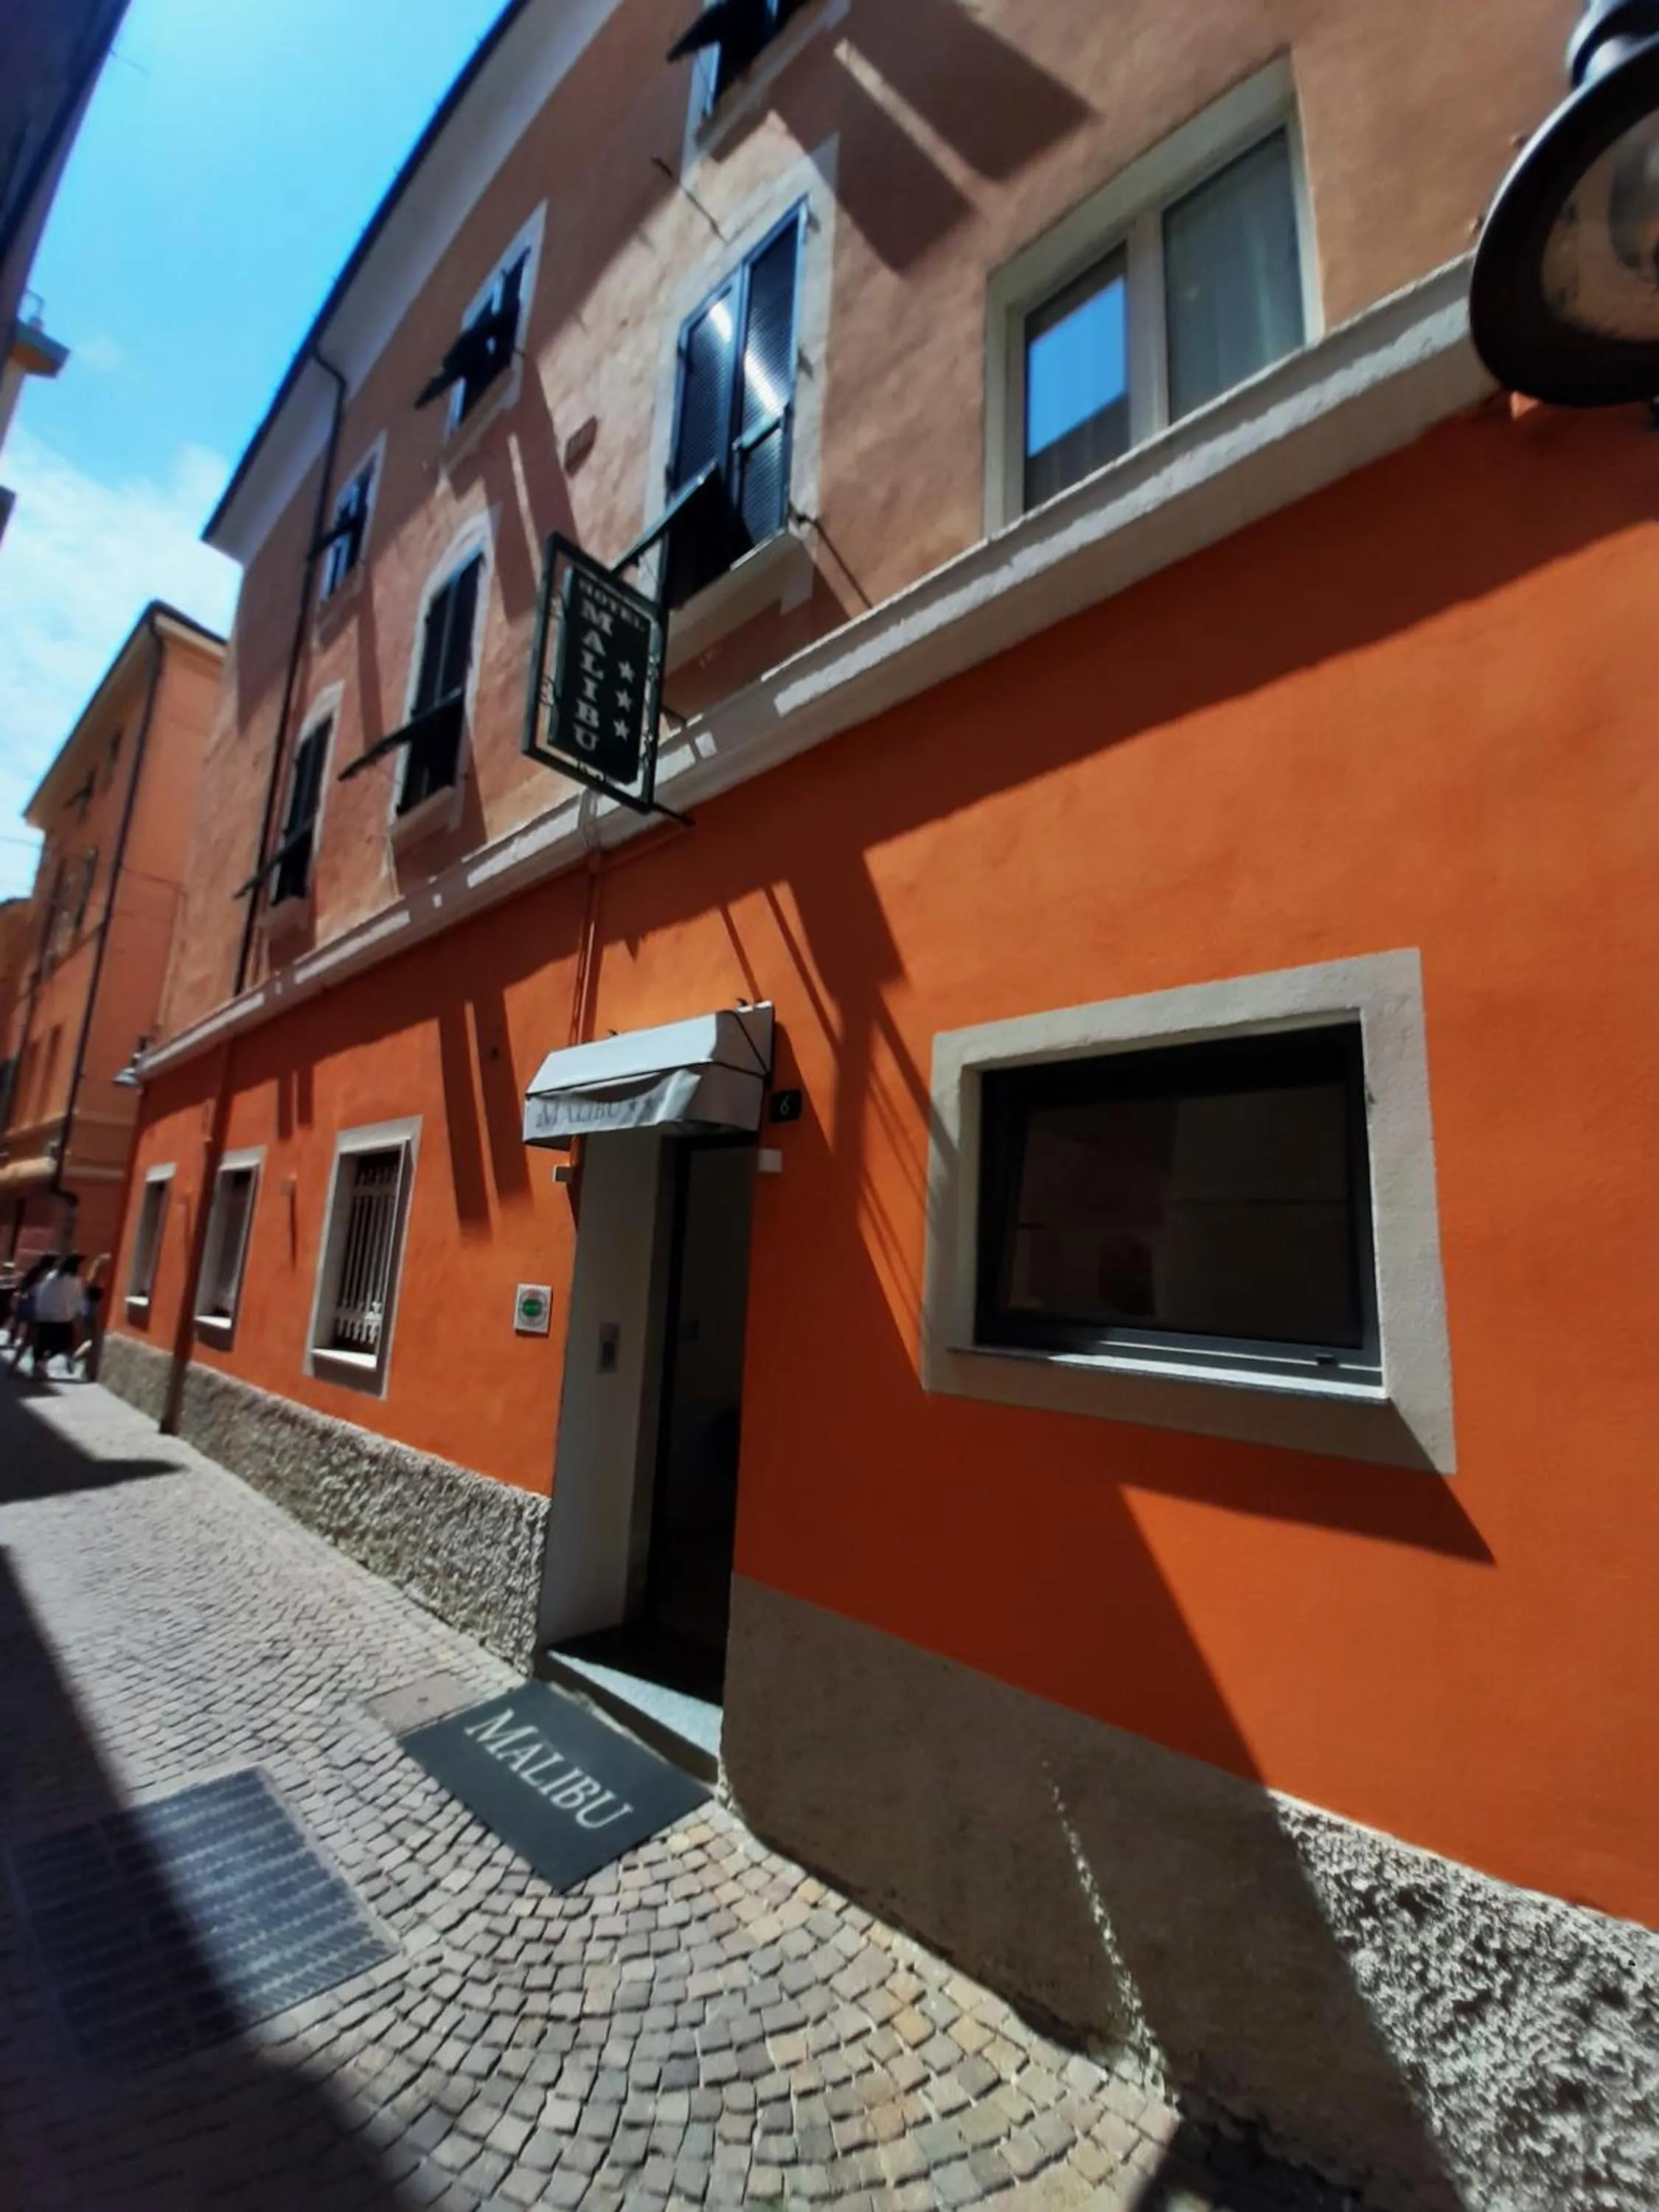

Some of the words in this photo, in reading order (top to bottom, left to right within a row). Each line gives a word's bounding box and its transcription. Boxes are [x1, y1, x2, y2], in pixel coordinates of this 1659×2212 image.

[578, 577, 646, 633] HOTEL
[573, 596, 613, 752] MALIBU
[779, 1094, 791, 1115] 6
[464, 1708, 634, 1829] MALIBU
